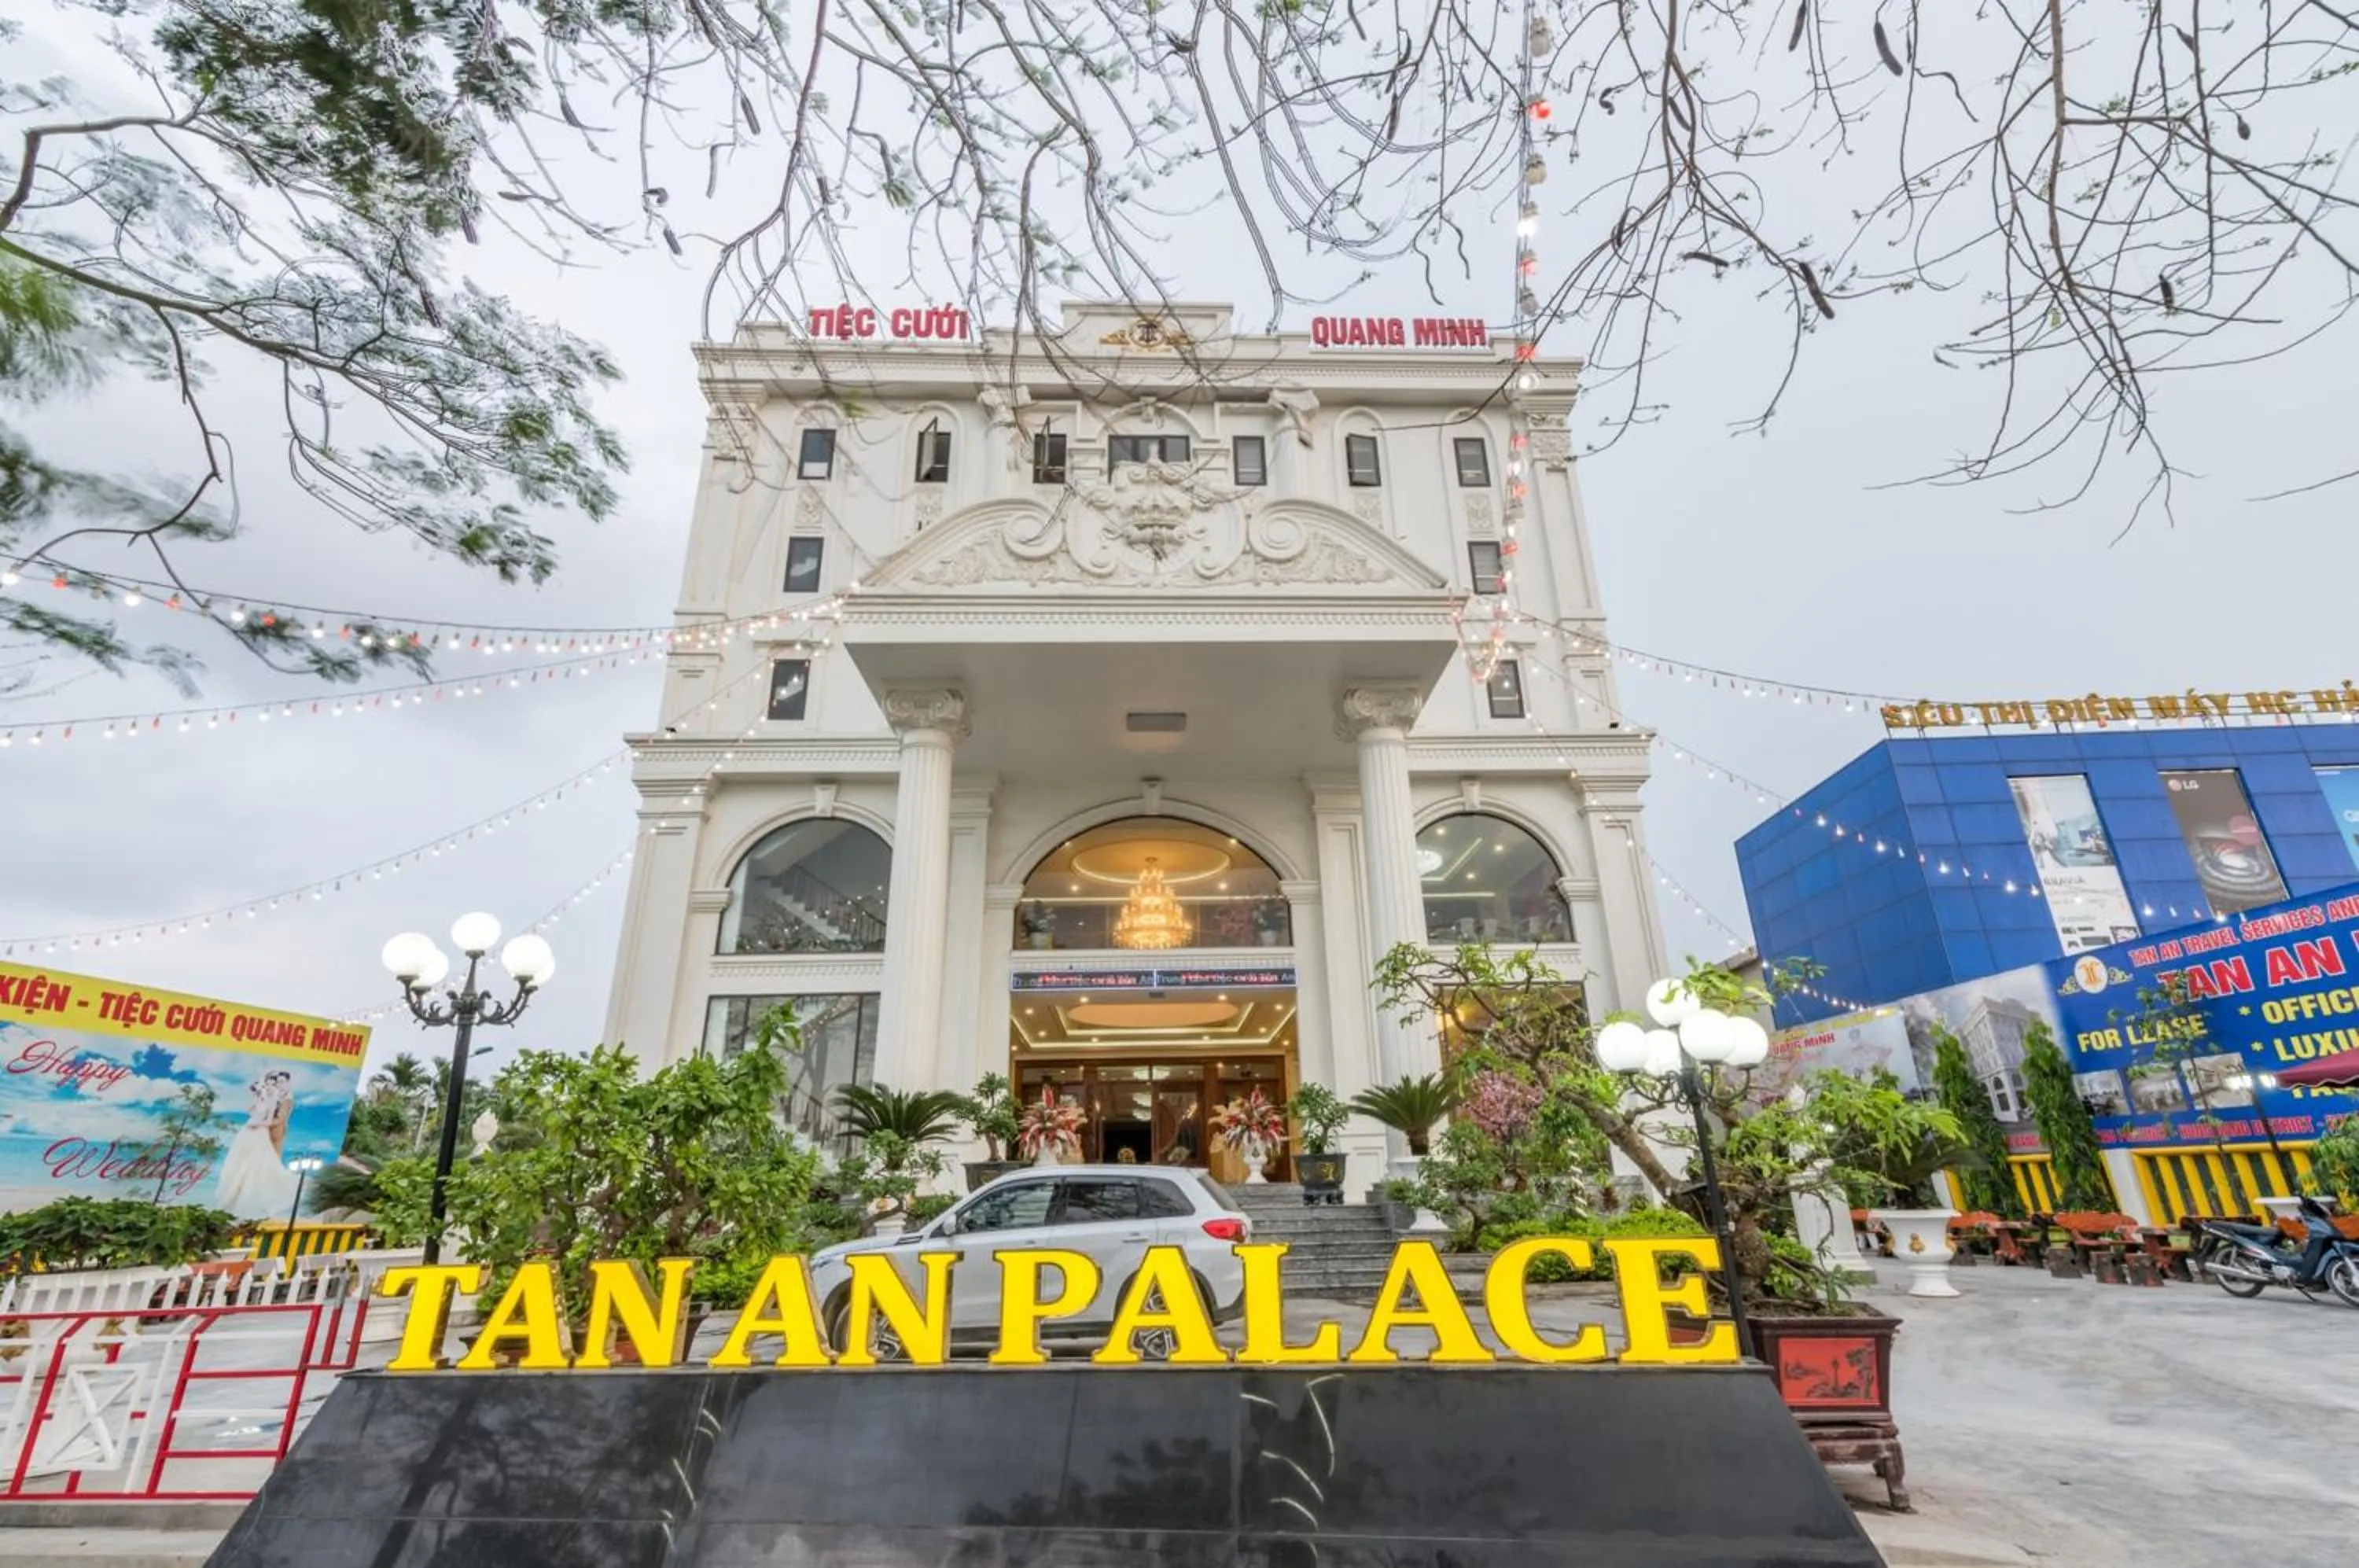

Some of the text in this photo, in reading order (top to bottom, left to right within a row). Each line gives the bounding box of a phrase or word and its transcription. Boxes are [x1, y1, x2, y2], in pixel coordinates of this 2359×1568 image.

[808, 302, 968, 340] TIỆC CƯỚI
[1312, 317, 1486, 348] QUANG MINH
[2182, 779, 2199, 790] LG
[2181, 926, 2241, 955] TRAVEL
[2240, 905, 2325, 942] SERVICES
[2156, 955, 2255, 1006] TAN
[2265, 936, 2346, 988] AN
[0, 974, 72, 1014] KIỆN
[98, 992, 160, 1028] TIỆC
[164, 1003, 226, 1036] CƯỚI
[230, 1015, 306, 1047] QUANG
[311, 1028, 363, 1056] MINH
[7, 1040, 132, 1091] Happy
[2077, 1028, 2122, 1054] FOR
[43, 1136, 212, 1196] Wedding
[381, 1235, 1741, 1370] TAN AN PALACE
